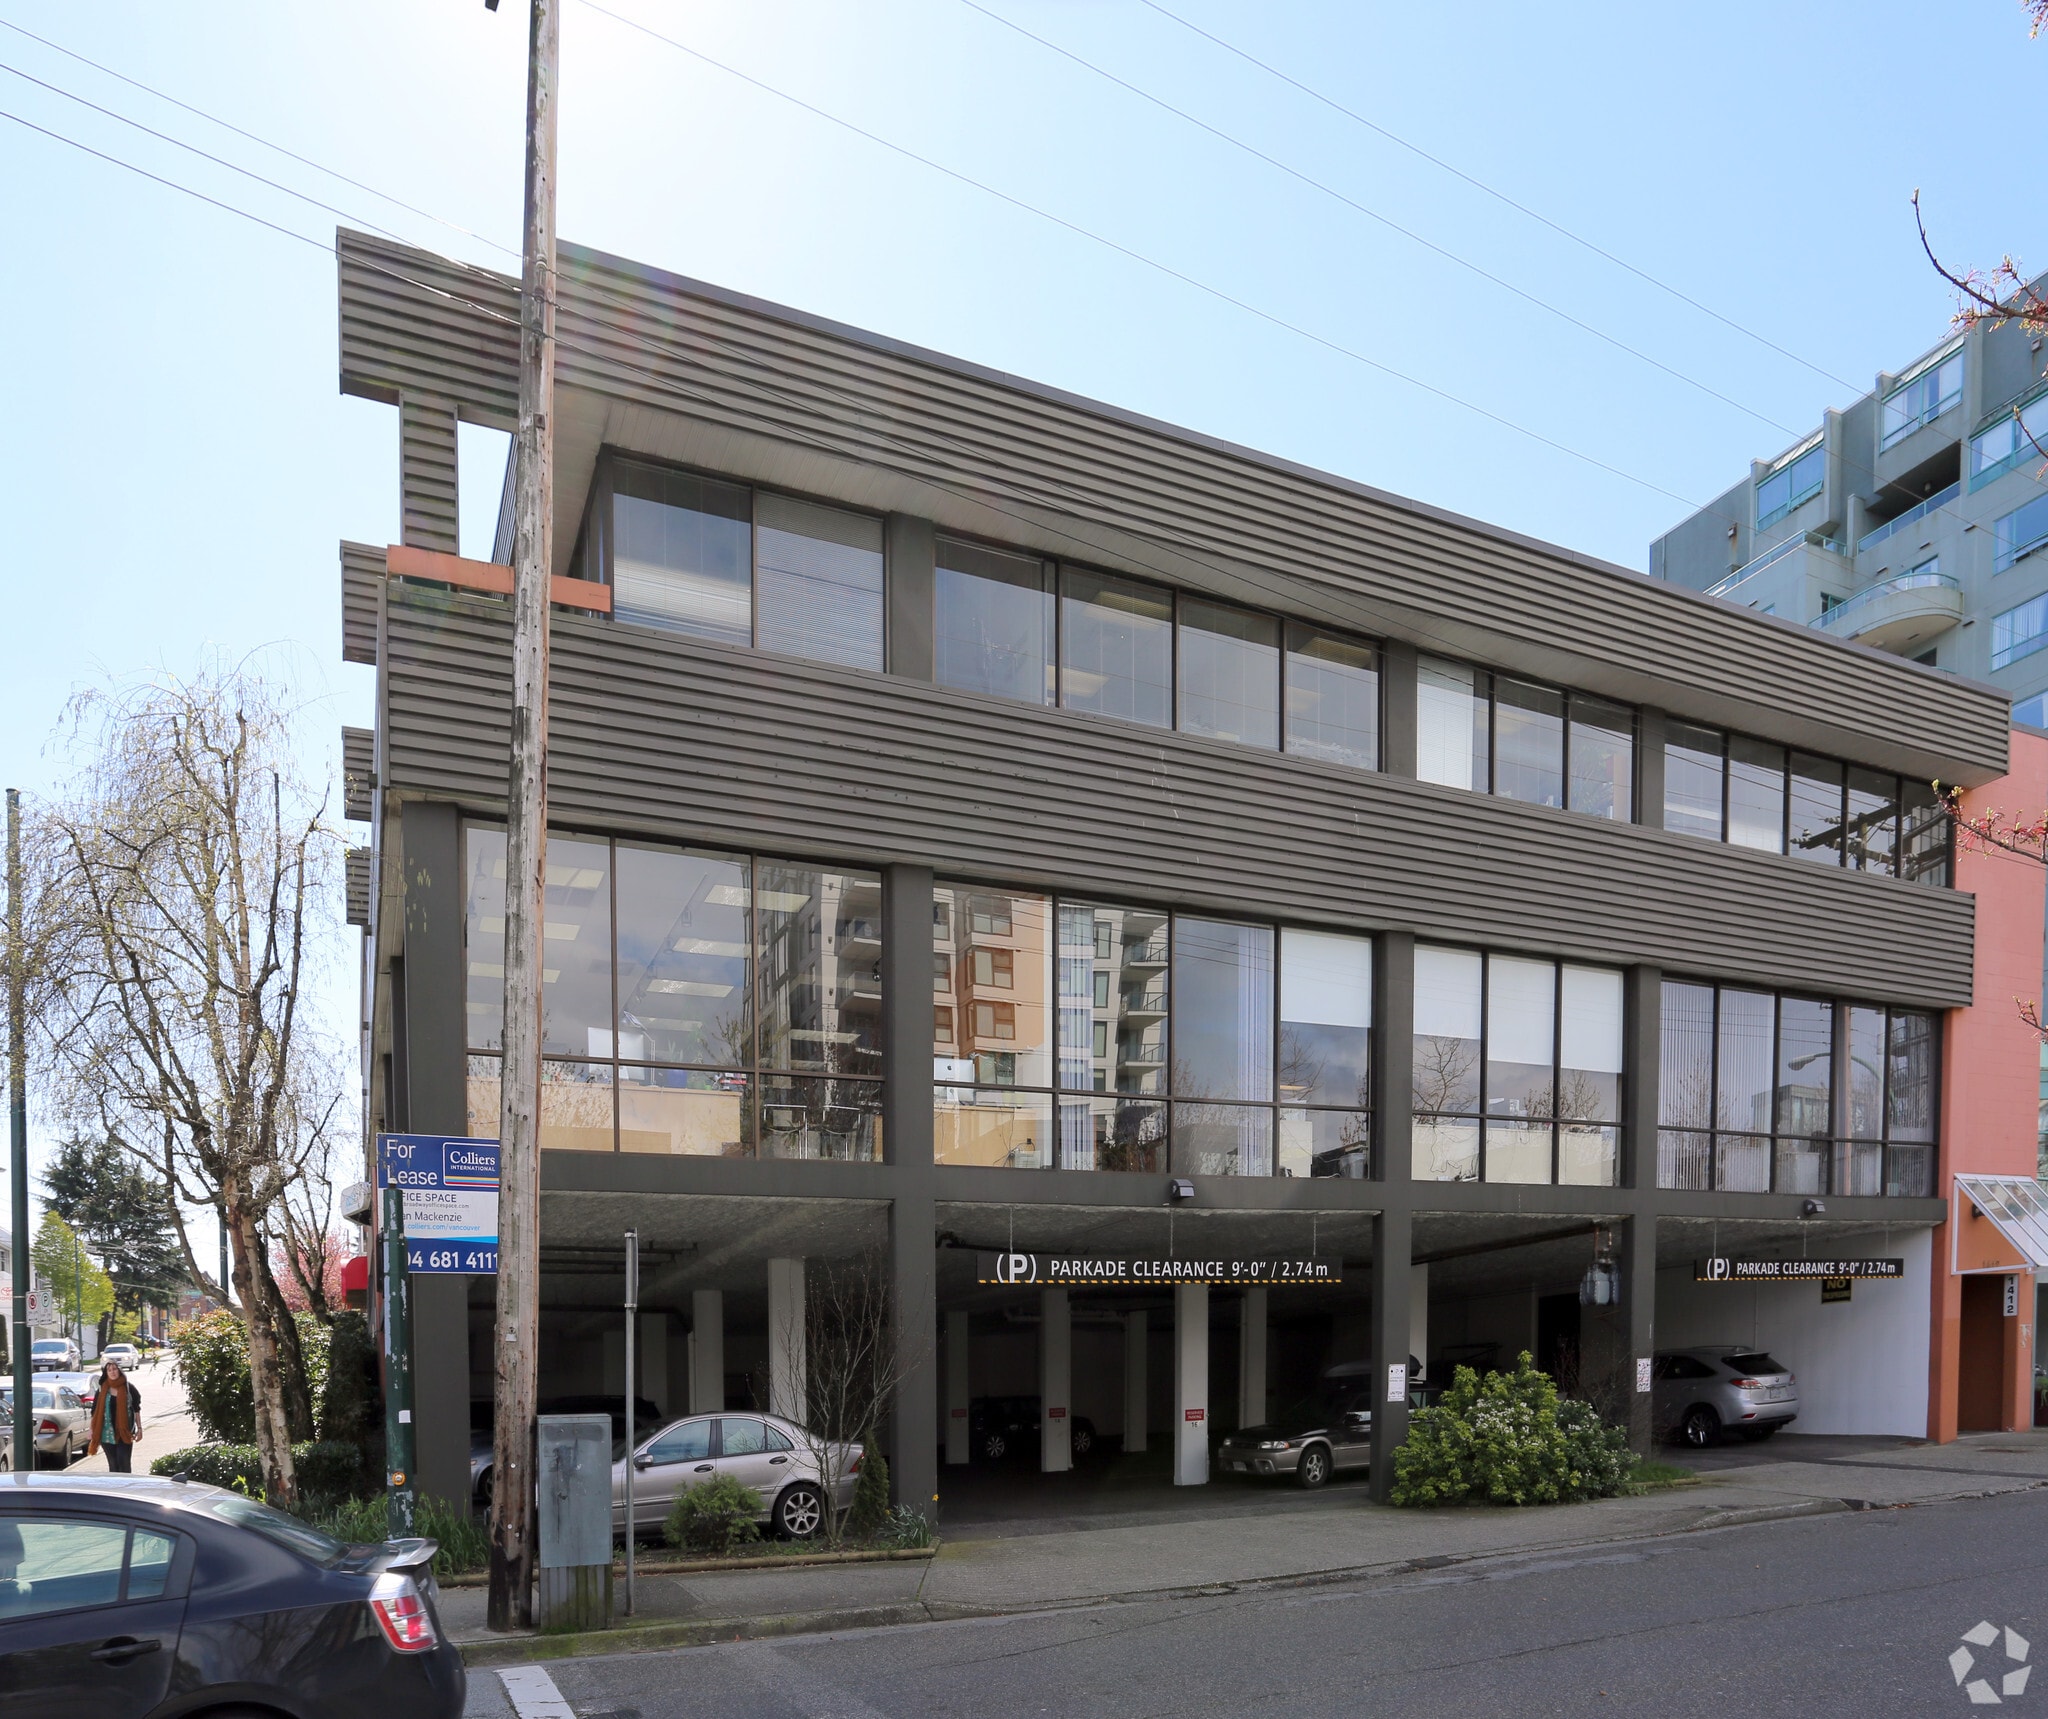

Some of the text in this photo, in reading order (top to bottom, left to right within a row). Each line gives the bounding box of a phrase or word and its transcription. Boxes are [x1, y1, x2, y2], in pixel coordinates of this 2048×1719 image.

[387, 1139, 416, 1159] For
[450, 1151, 496, 1165] Colliers
[387, 1165, 438, 1186] Lease
[402, 1192, 457, 1203] FICE SPACE
[414, 1211, 463, 1222] Mackenzie
[406, 1223, 481, 1231] .colliers.com/vancouver
[430, 1251, 459, 1268] 681
[1050, 1260, 1126, 1277] PARKADE
[1132, 1260, 1224, 1278] CLEARANCE
[1736, 1262, 1780, 1275] PARKADE
[1782, 1262, 1835, 1275] CLEARANCE
[1826, 1279, 1847, 1290] NO
[2007, 1276, 2015, 1314] 1412
